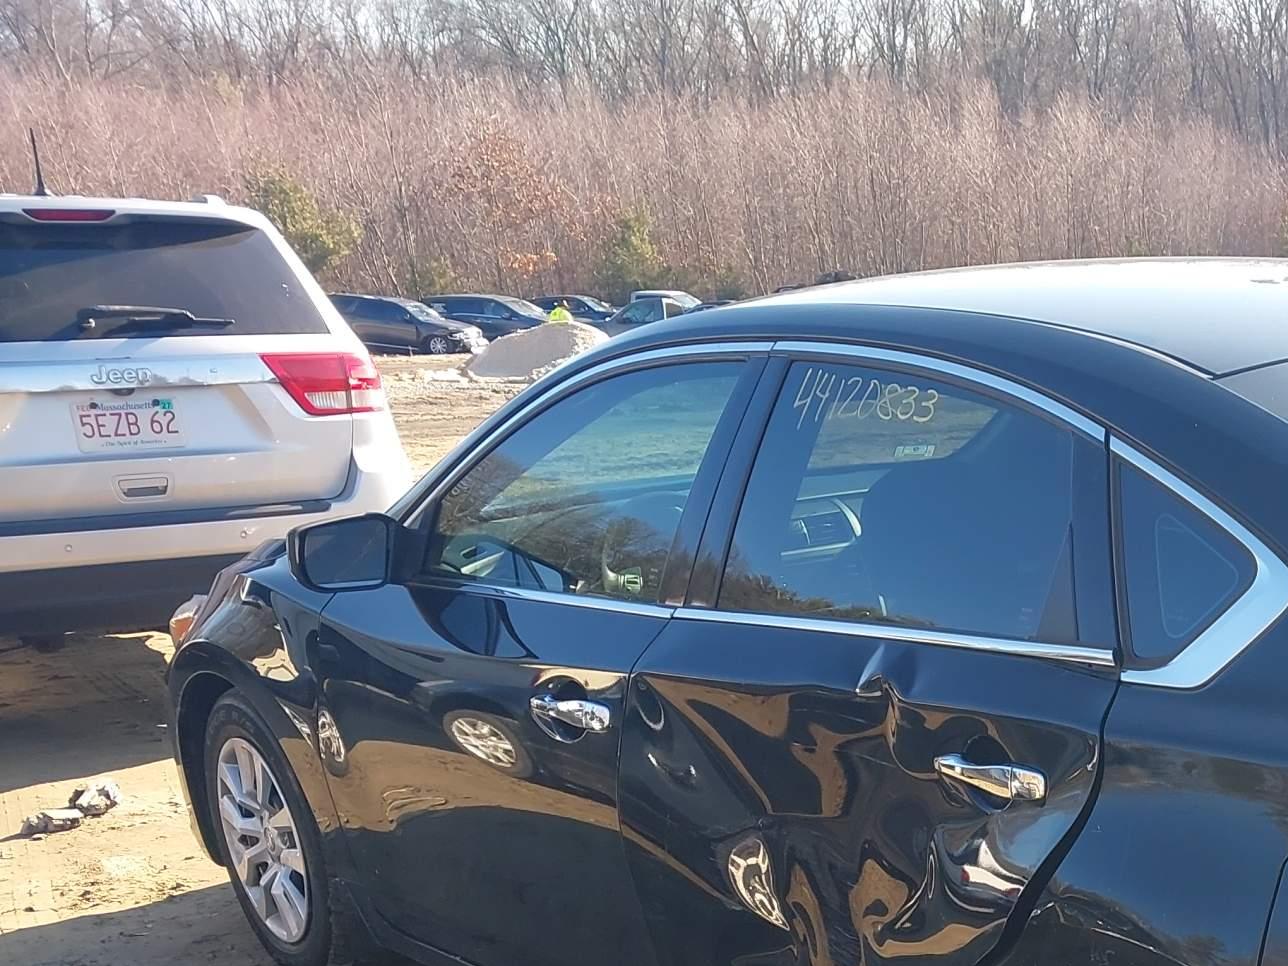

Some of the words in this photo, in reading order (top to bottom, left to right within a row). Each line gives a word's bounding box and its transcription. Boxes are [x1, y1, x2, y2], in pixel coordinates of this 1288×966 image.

[90, 365, 152, 385] Jeep
[793, 367, 939, 431] 44120833
[79, 412, 141, 438] 5EZB
[150, 410, 179, 434] 62
